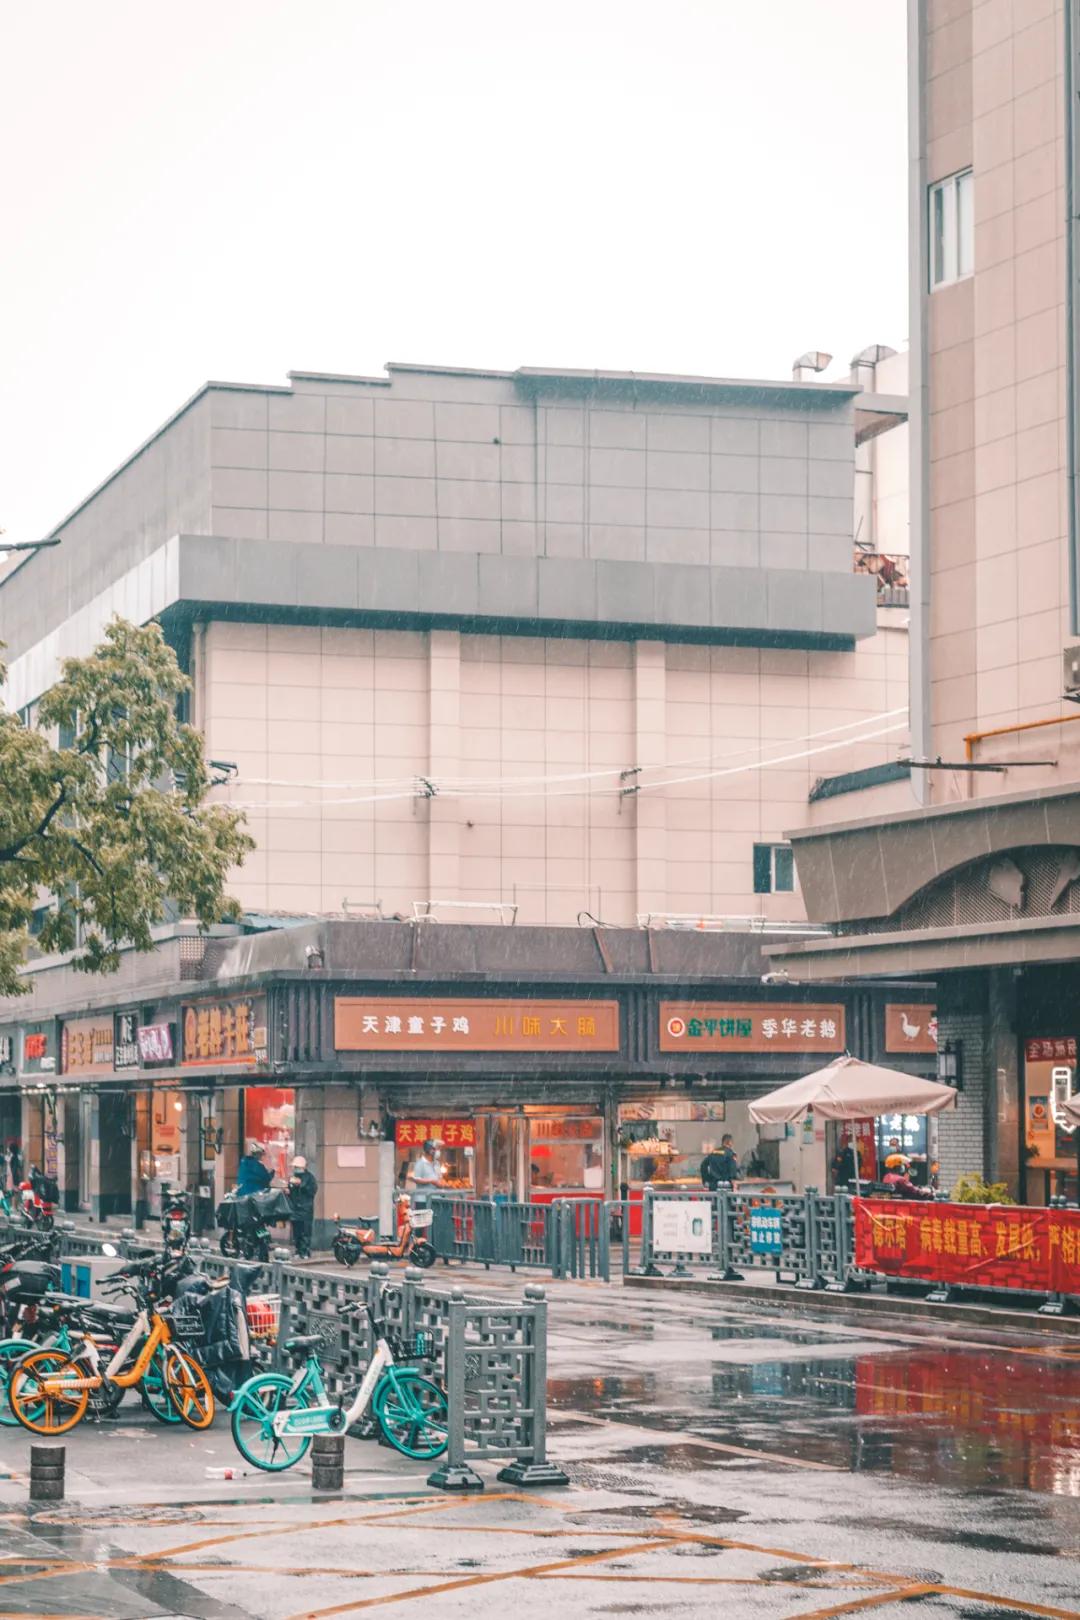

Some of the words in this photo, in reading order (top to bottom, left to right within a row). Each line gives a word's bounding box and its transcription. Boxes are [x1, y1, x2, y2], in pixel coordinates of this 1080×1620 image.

[361, 1015, 470, 1035] 天津童子鸡
